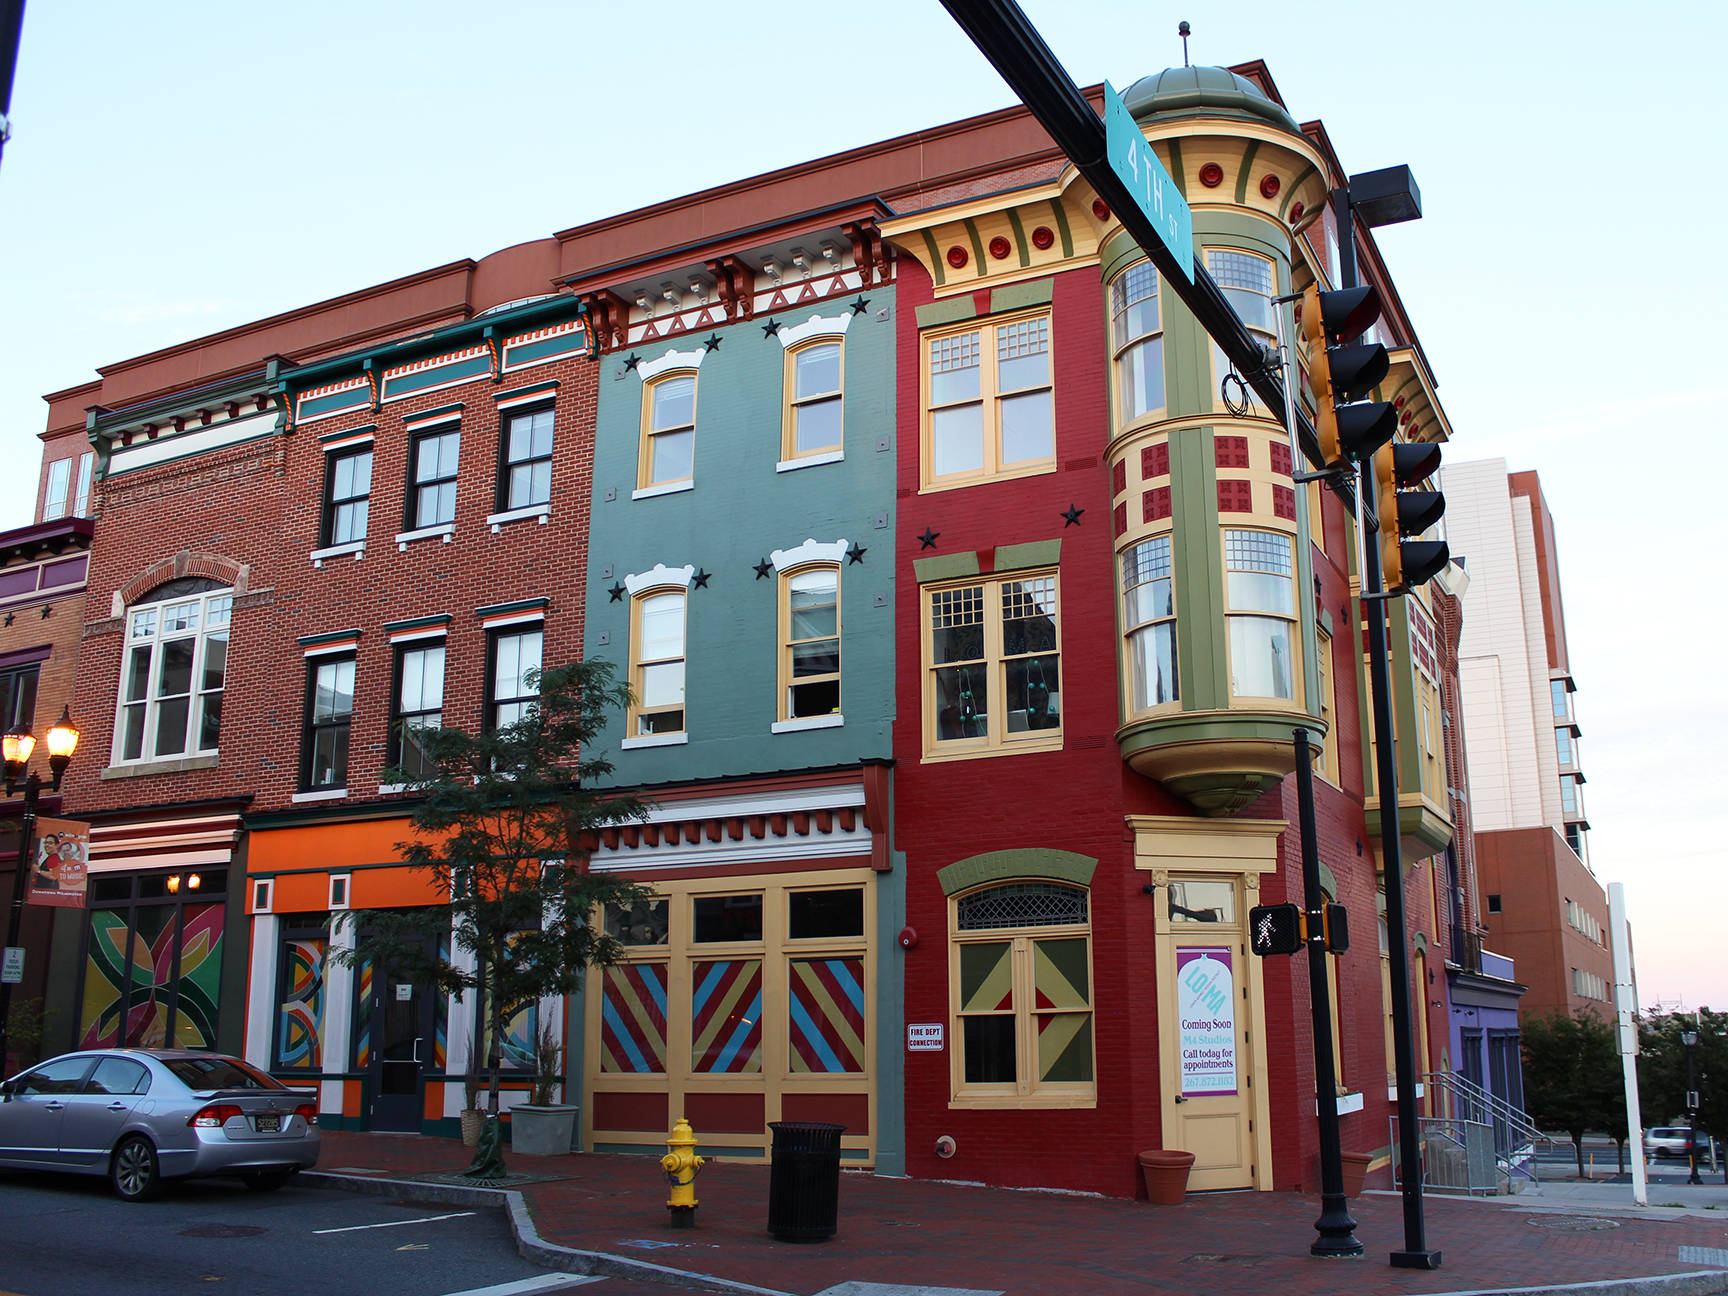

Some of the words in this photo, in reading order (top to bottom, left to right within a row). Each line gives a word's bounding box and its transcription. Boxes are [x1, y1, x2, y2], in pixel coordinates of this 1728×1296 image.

[1169, 213, 1178, 242] ST
[1182, 1019, 1211, 1032] Coming
[1212, 1018, 1232, 1029] Soon
[911, 1028, 923, 1036] FIRE
[925, 1028, 940, 1036] DEPT
[1199, 1034, 1232, 1044] Studios
[1183, 1049, 1198, 1059] Call
[1199, 1049, 1221, 1060] today
[1222, 1048, 1233, 1058] for
[1184, 1059, 1233, 1072] appointments
